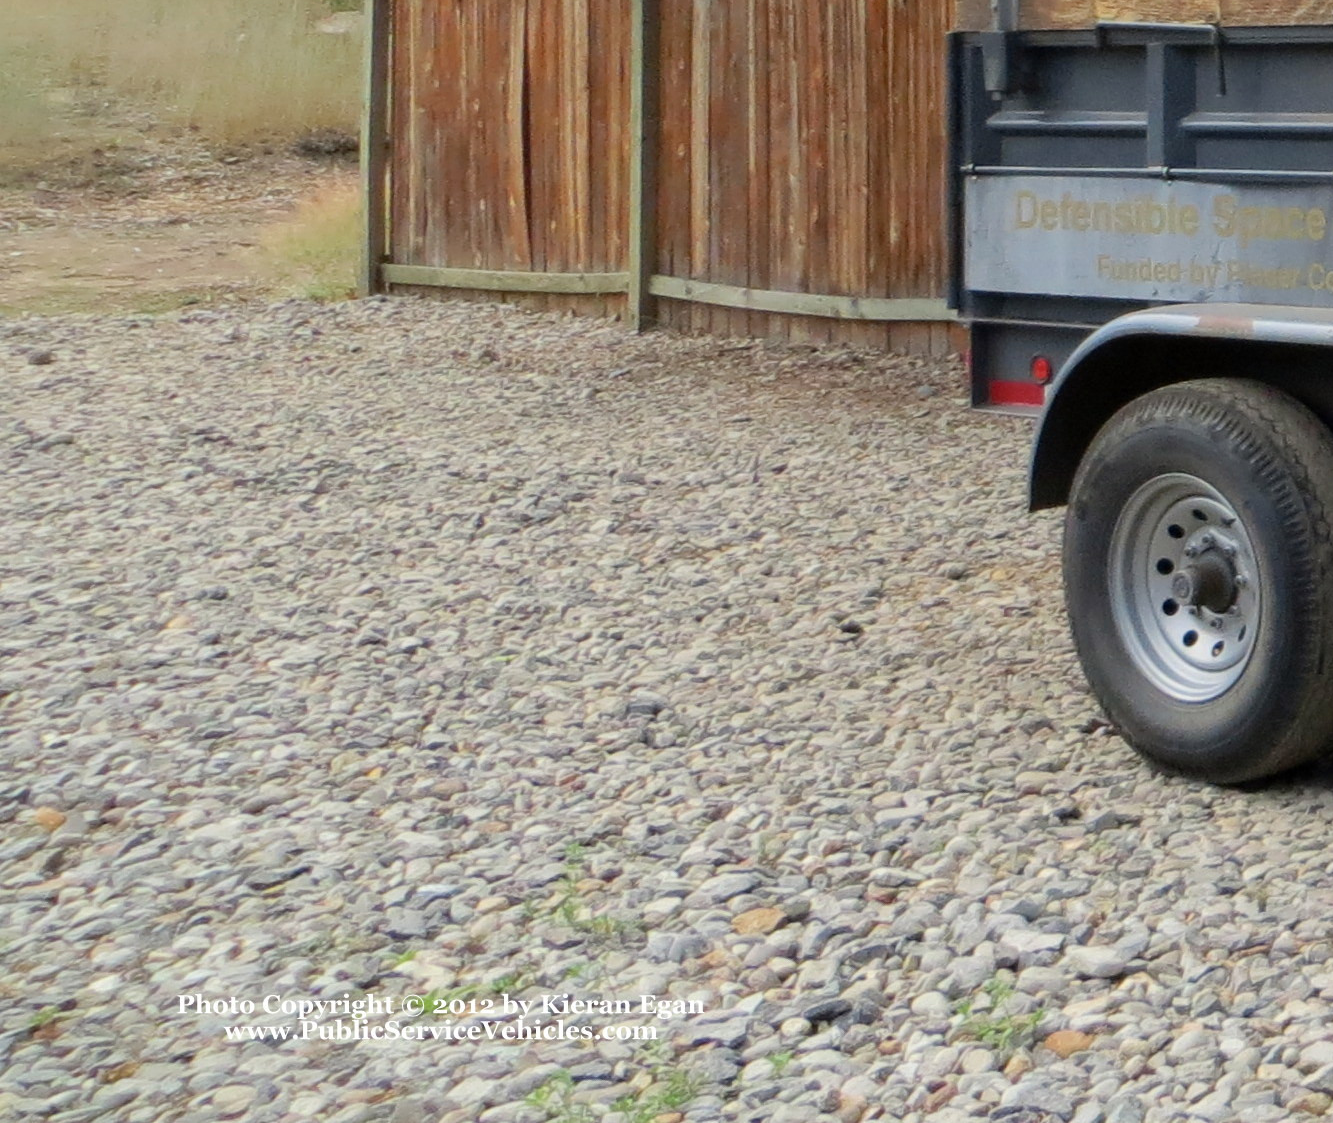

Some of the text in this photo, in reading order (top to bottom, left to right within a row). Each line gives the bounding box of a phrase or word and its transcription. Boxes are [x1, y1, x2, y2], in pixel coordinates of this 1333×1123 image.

[1015, 190, 1200, 236] Defensible
[1212, 195, 1326, 249] Space
[1096, 254, 1181, 283] Funded
[1189, 259, 1219, 287] by
